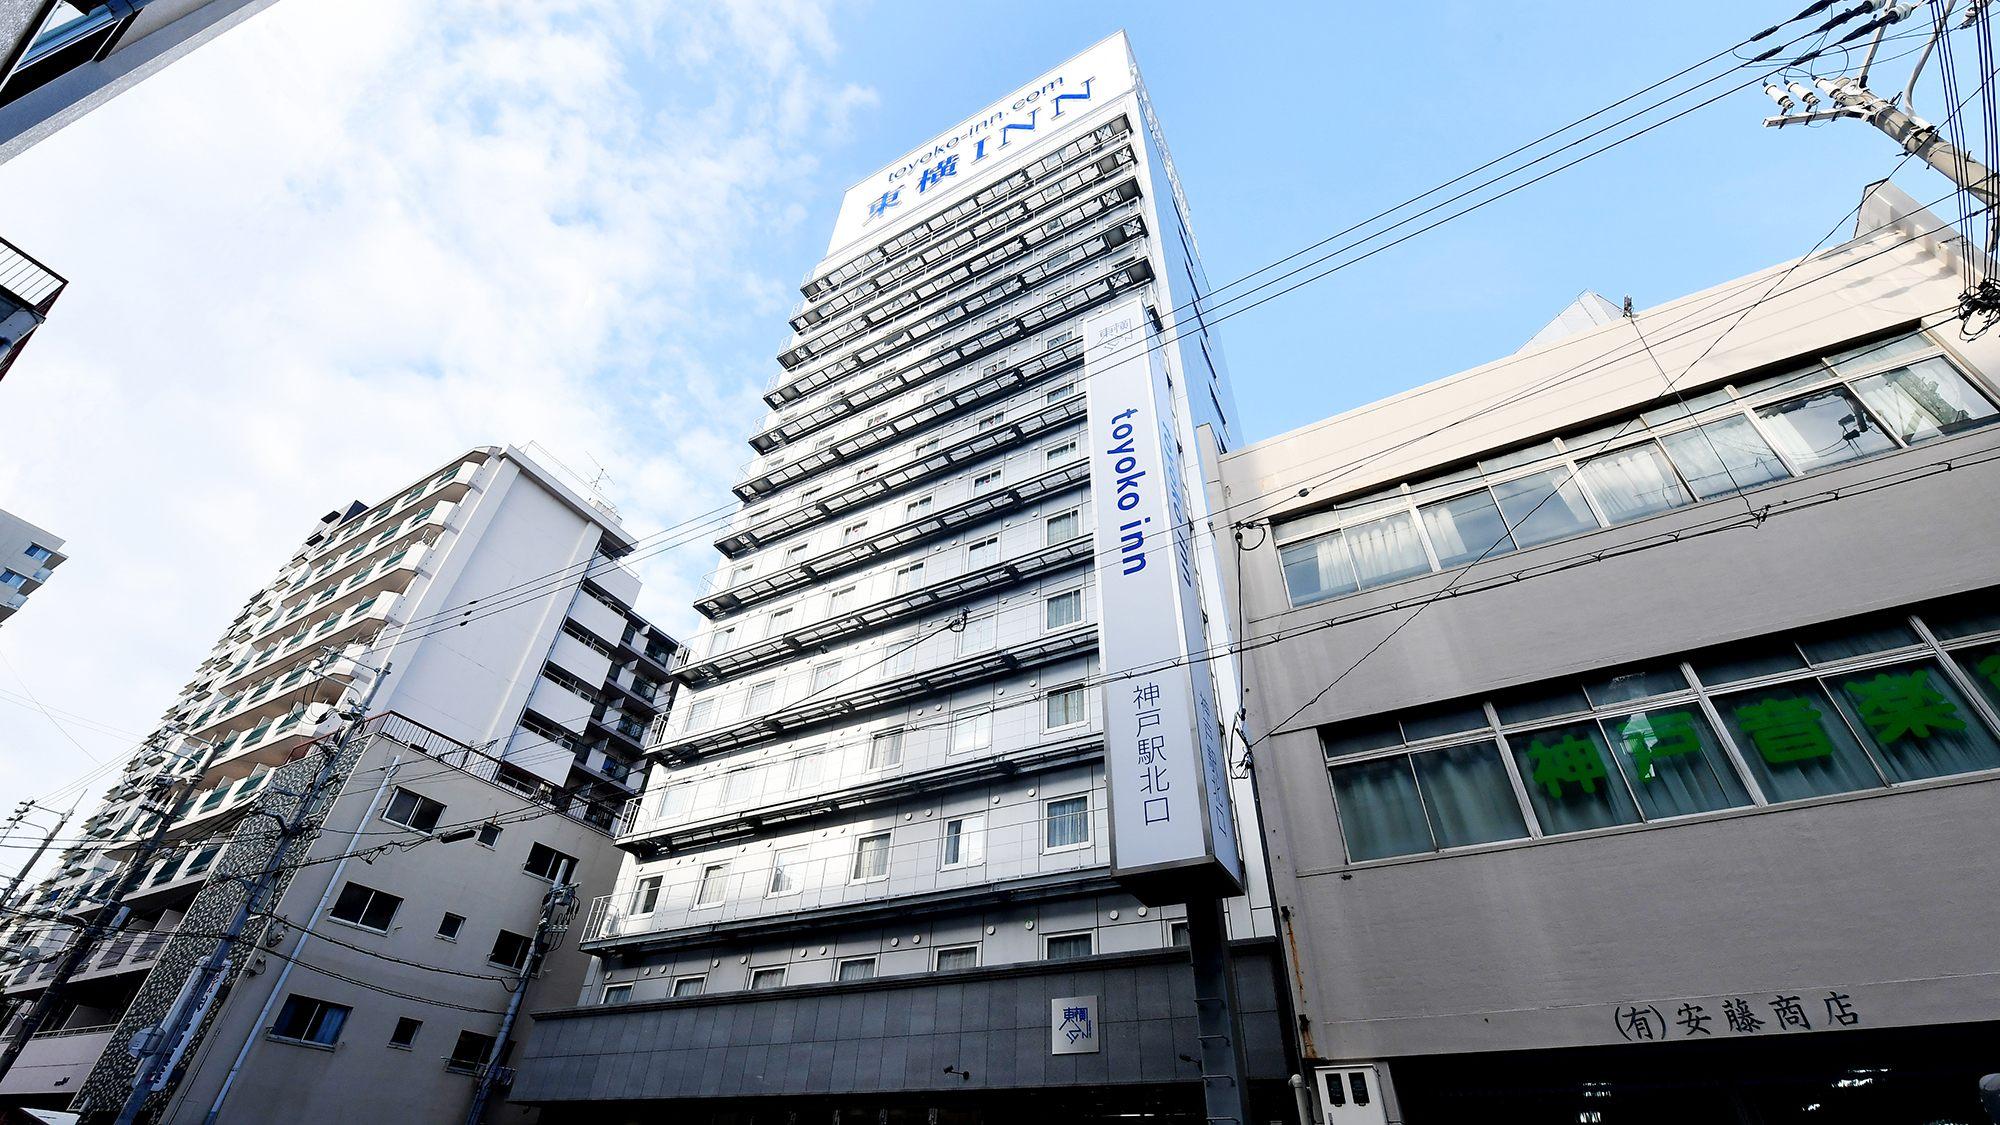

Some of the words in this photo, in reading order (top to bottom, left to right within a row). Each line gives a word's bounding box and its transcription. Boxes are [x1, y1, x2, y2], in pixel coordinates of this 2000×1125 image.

[888, 76, 1063, 182] toyoko-inn.com
[1107, 408, 1146, 511] toyoko
[1120, 516, 1151, 576] inn
[1132, 682, 1170, 826] 神戸駅北口
[1527, 654, 2000, 798] 神戸音楽
